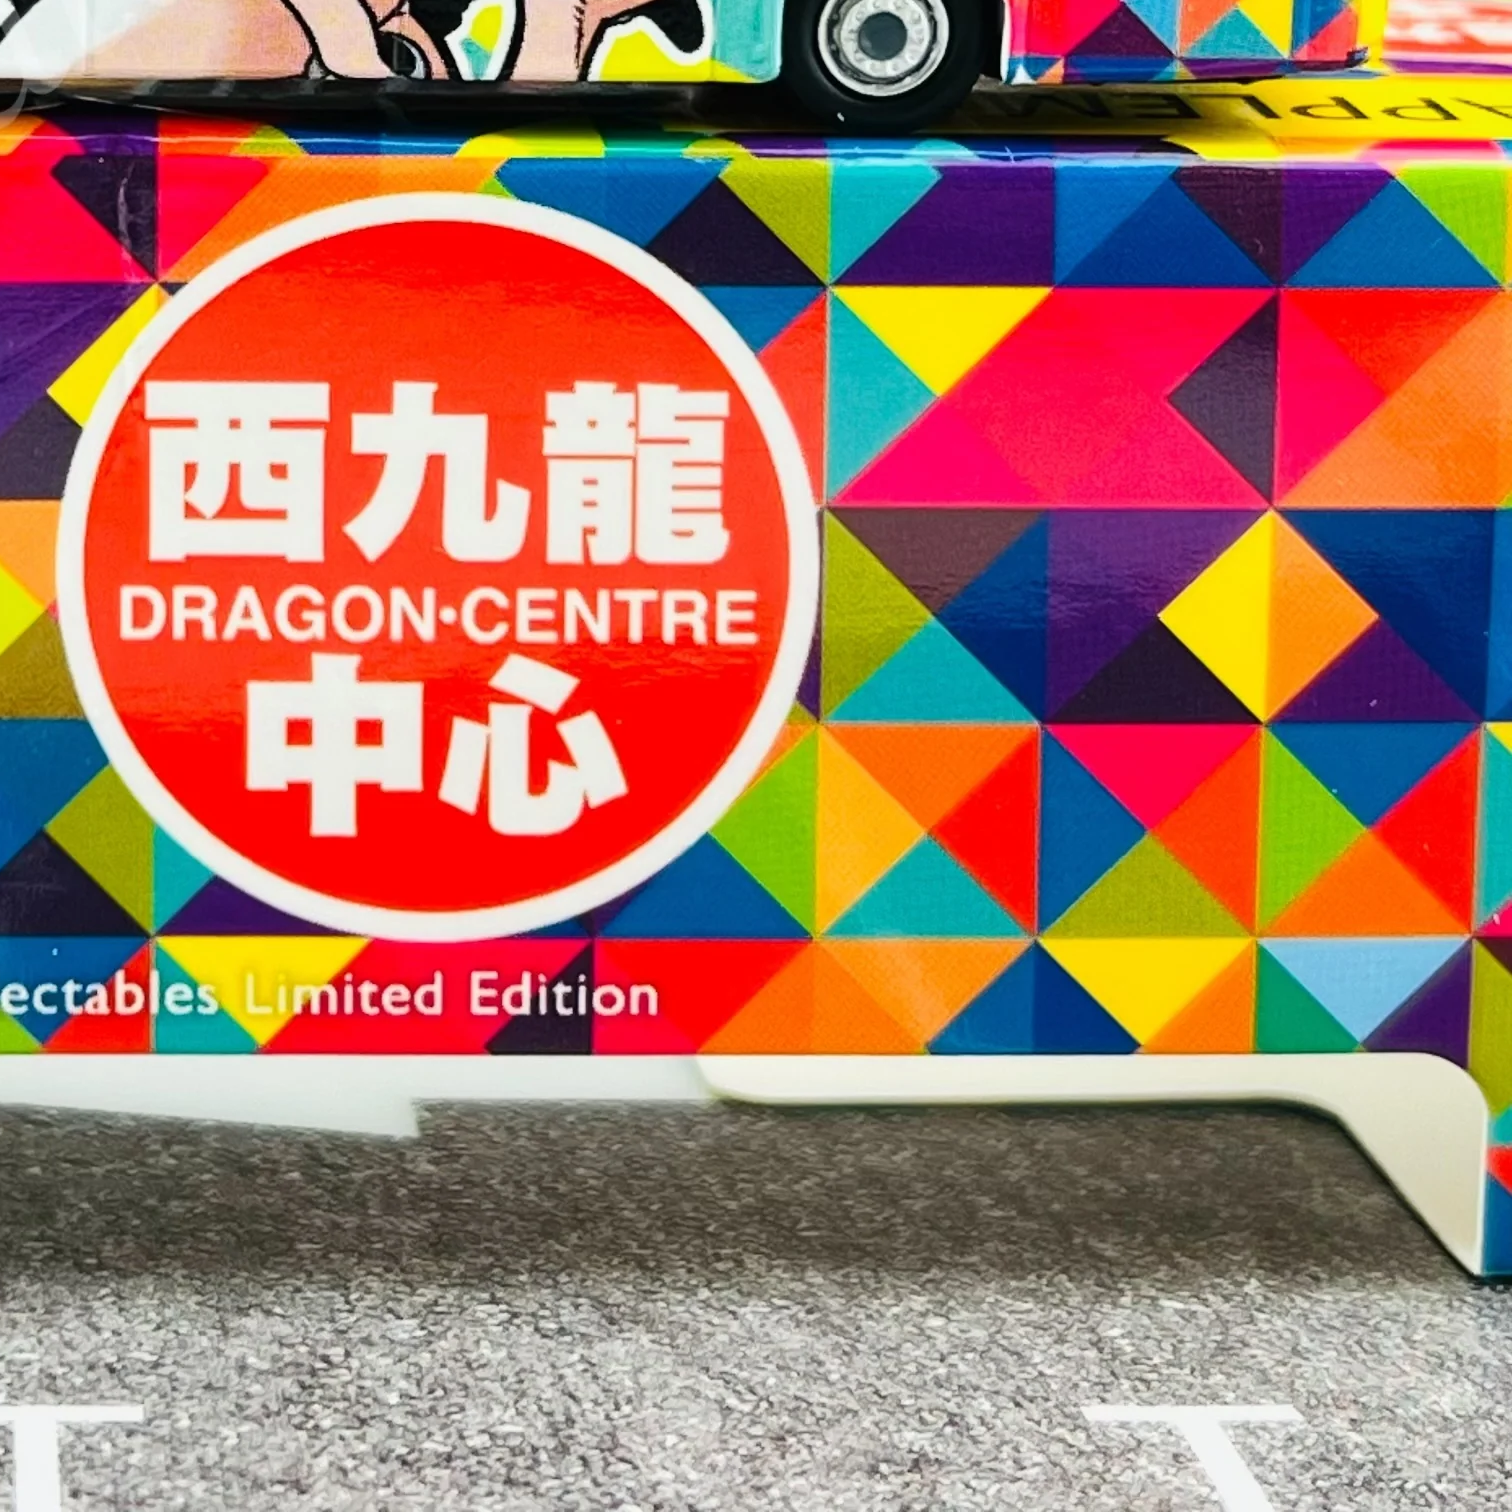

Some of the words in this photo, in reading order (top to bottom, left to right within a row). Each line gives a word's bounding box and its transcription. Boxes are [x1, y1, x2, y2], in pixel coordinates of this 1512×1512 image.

[144, 380, 730, 565] 西九龍
[245, 652, 629, 837] 中心
[244, 971, 442, 1016] Limited
[470, 970, 659, 1016] Edition
